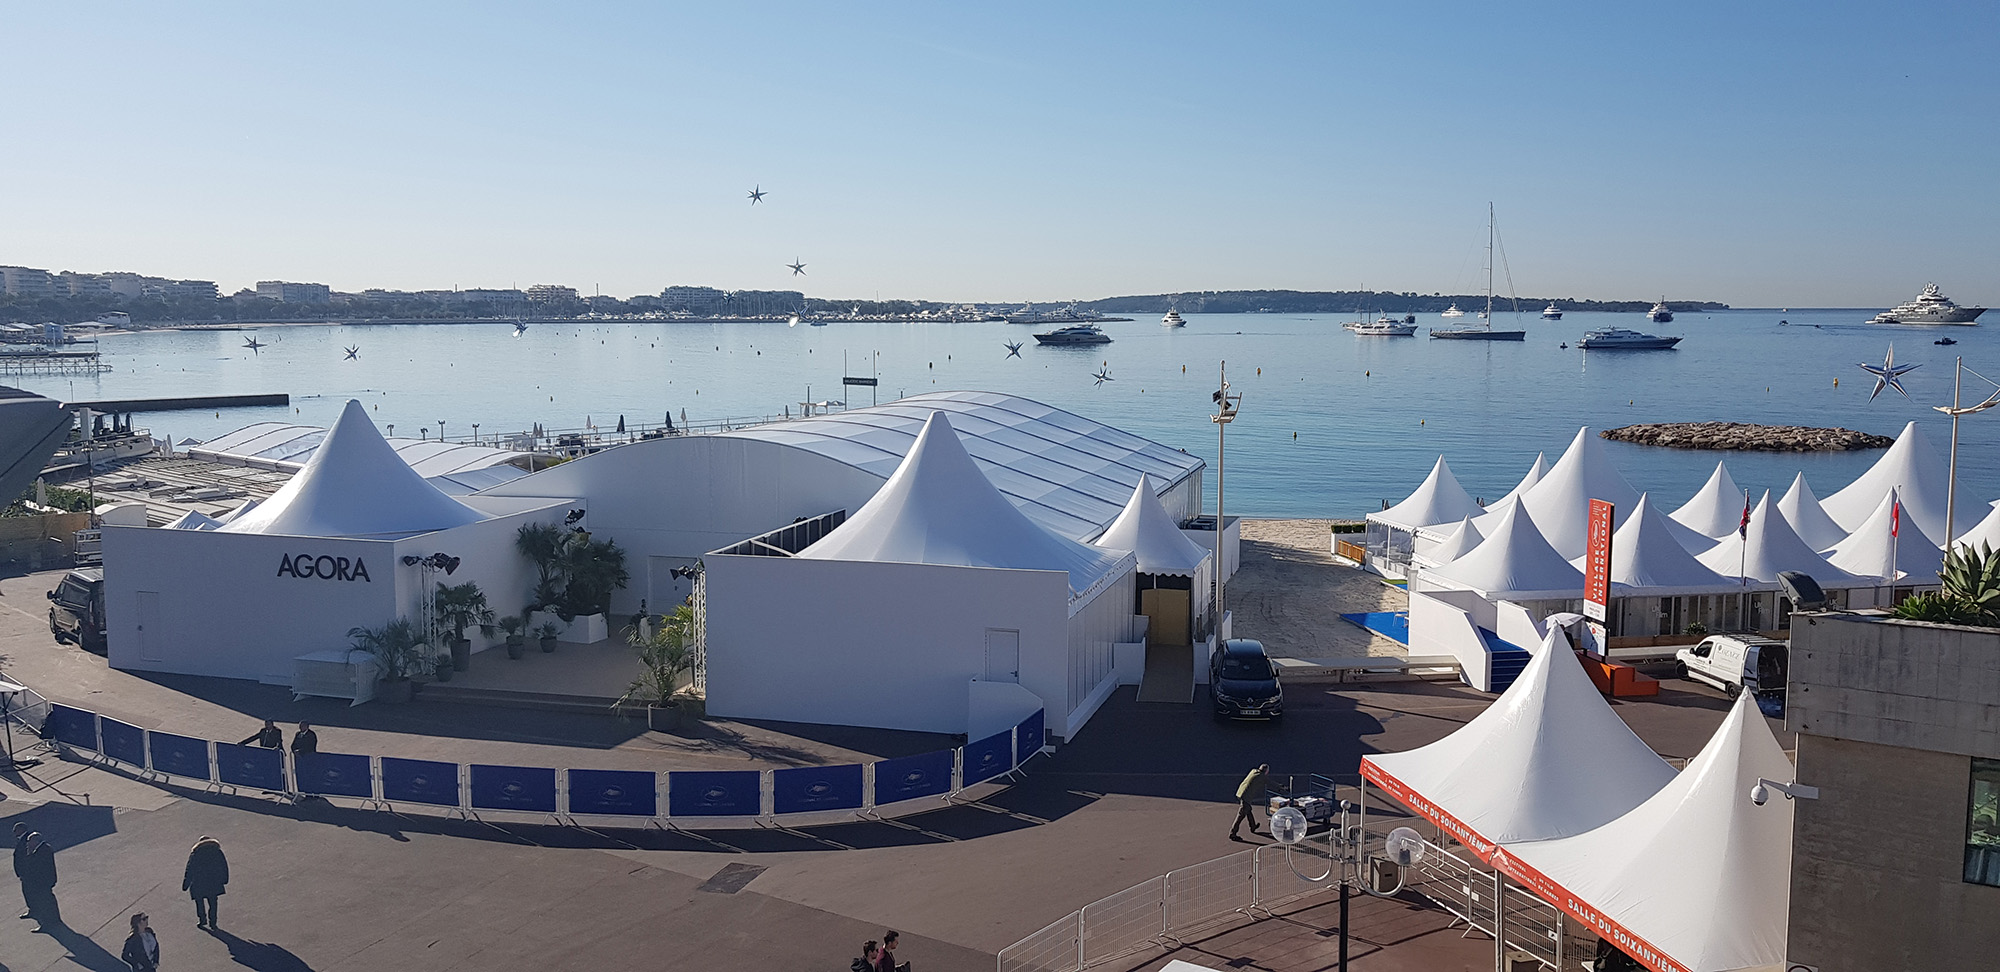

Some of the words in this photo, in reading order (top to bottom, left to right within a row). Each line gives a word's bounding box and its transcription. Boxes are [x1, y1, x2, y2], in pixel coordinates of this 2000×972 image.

[277, 553, 370, 582] AGORA
[1598, 506, 1607, 602] INTERNATIONAL
[1408, 794, 1428, 813] SALLE
[1430, 808, 1439, 820] DU
[1440, 815, 1487, 853] SOIXANTIÈME
[1568, 898, 1596, 924] SALLE
[1599, 918, 1611, 934] DU
